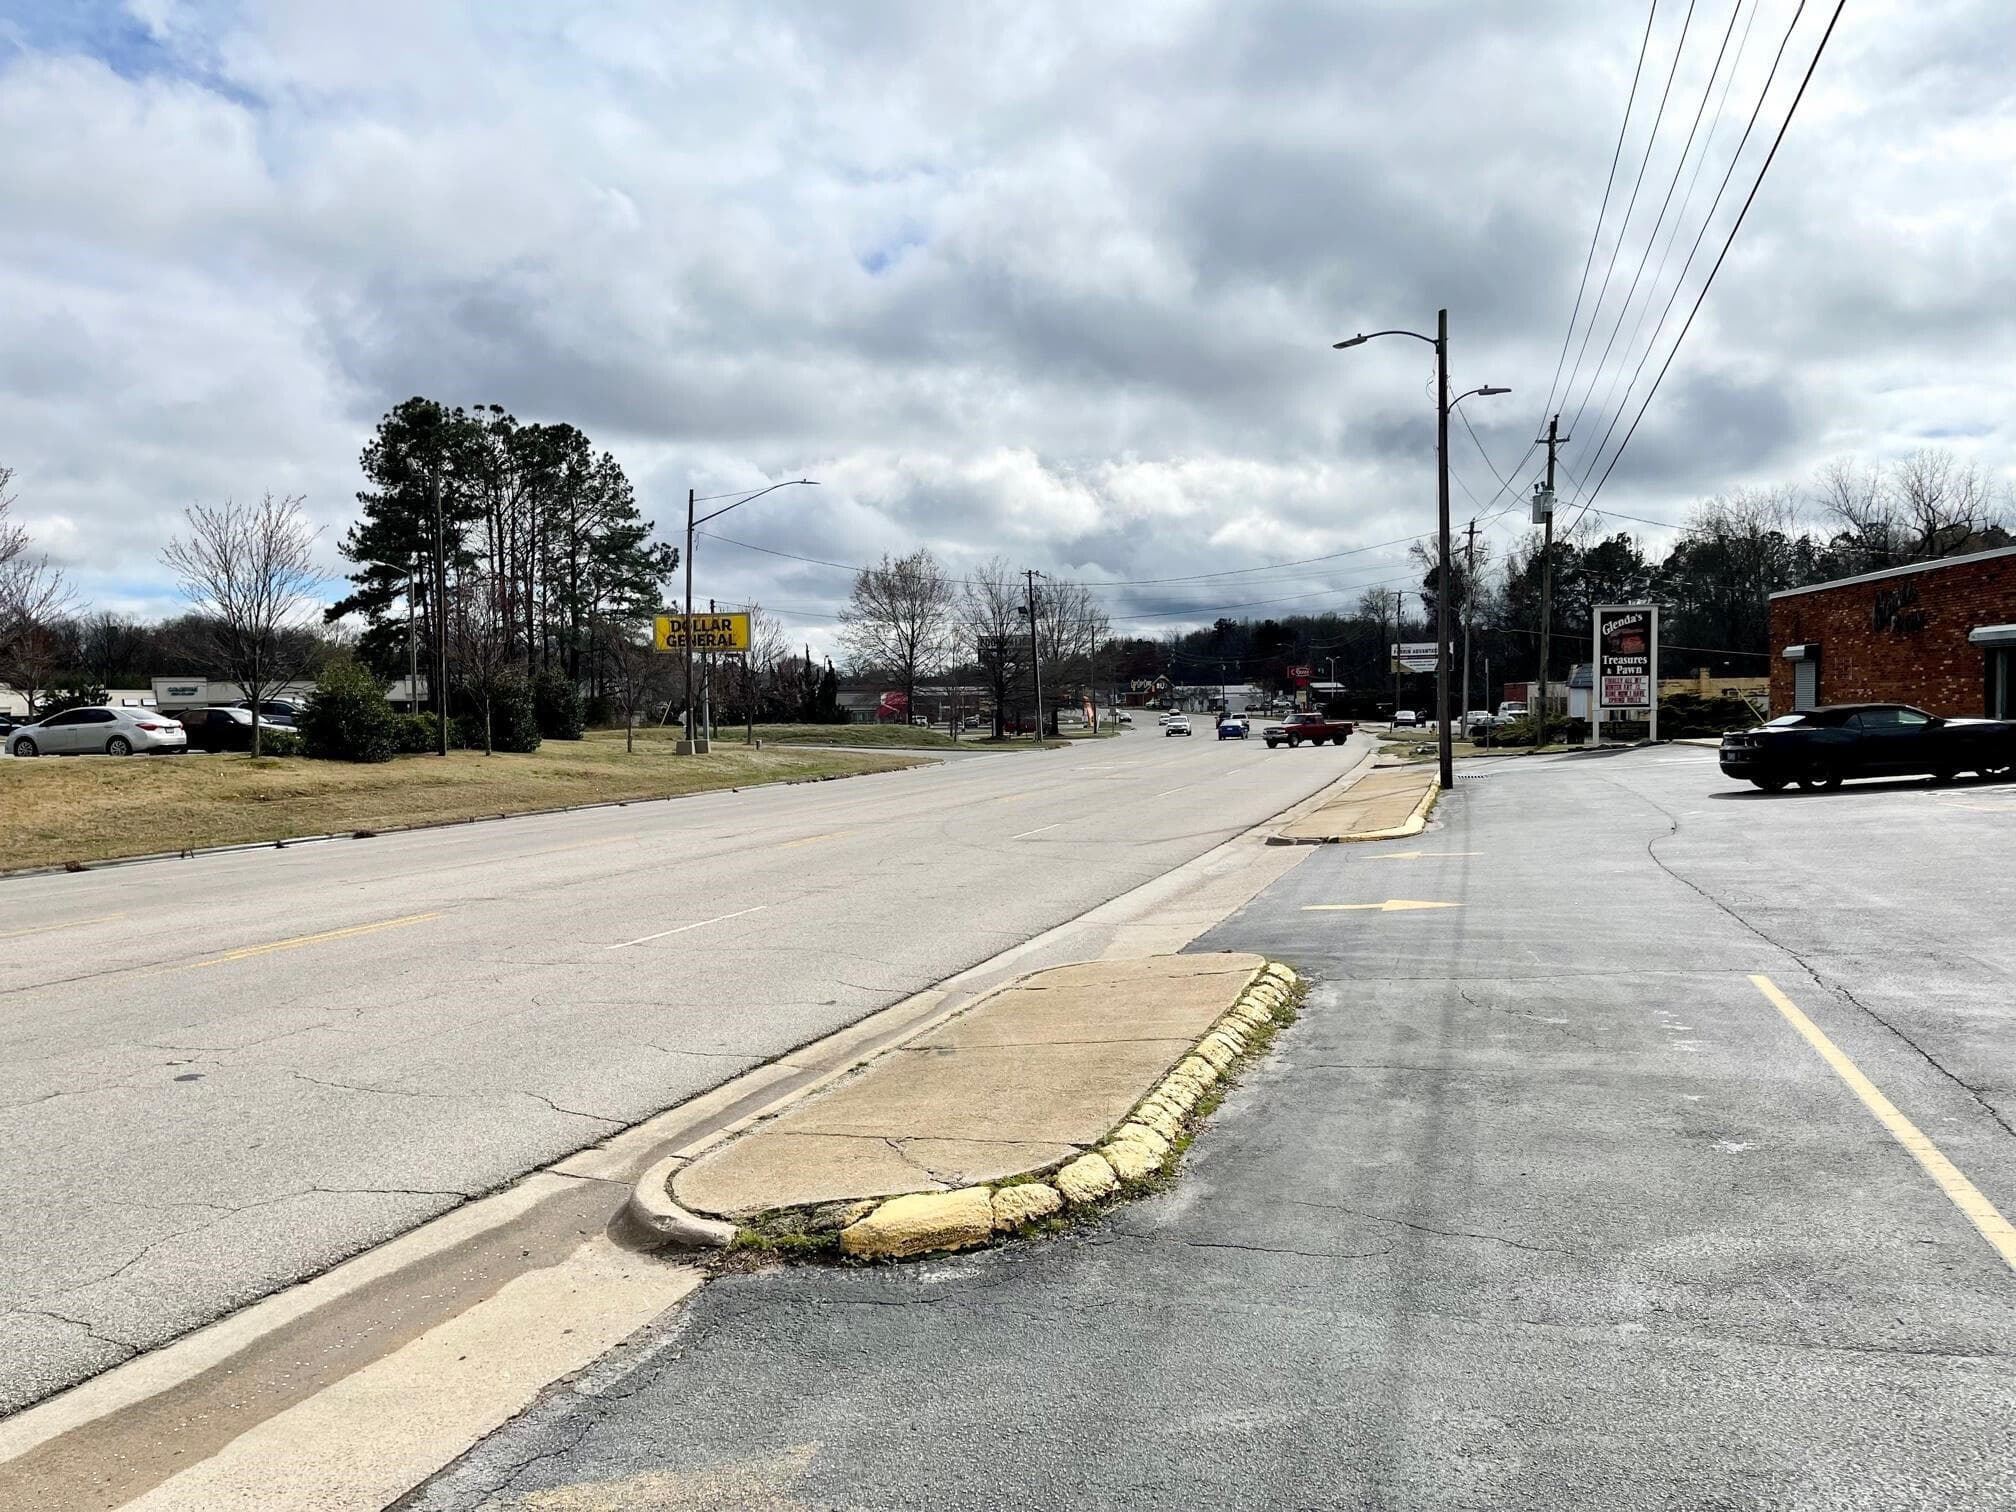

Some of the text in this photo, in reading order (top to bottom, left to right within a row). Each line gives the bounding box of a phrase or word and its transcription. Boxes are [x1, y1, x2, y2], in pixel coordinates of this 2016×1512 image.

[1602, 613, 1643, 635] Glenda's
[667, 634, 737, 647] GENERAL
[1602, 655, 1648, 665] Treasures
[1616, 665, 1643, 675] Pawn
